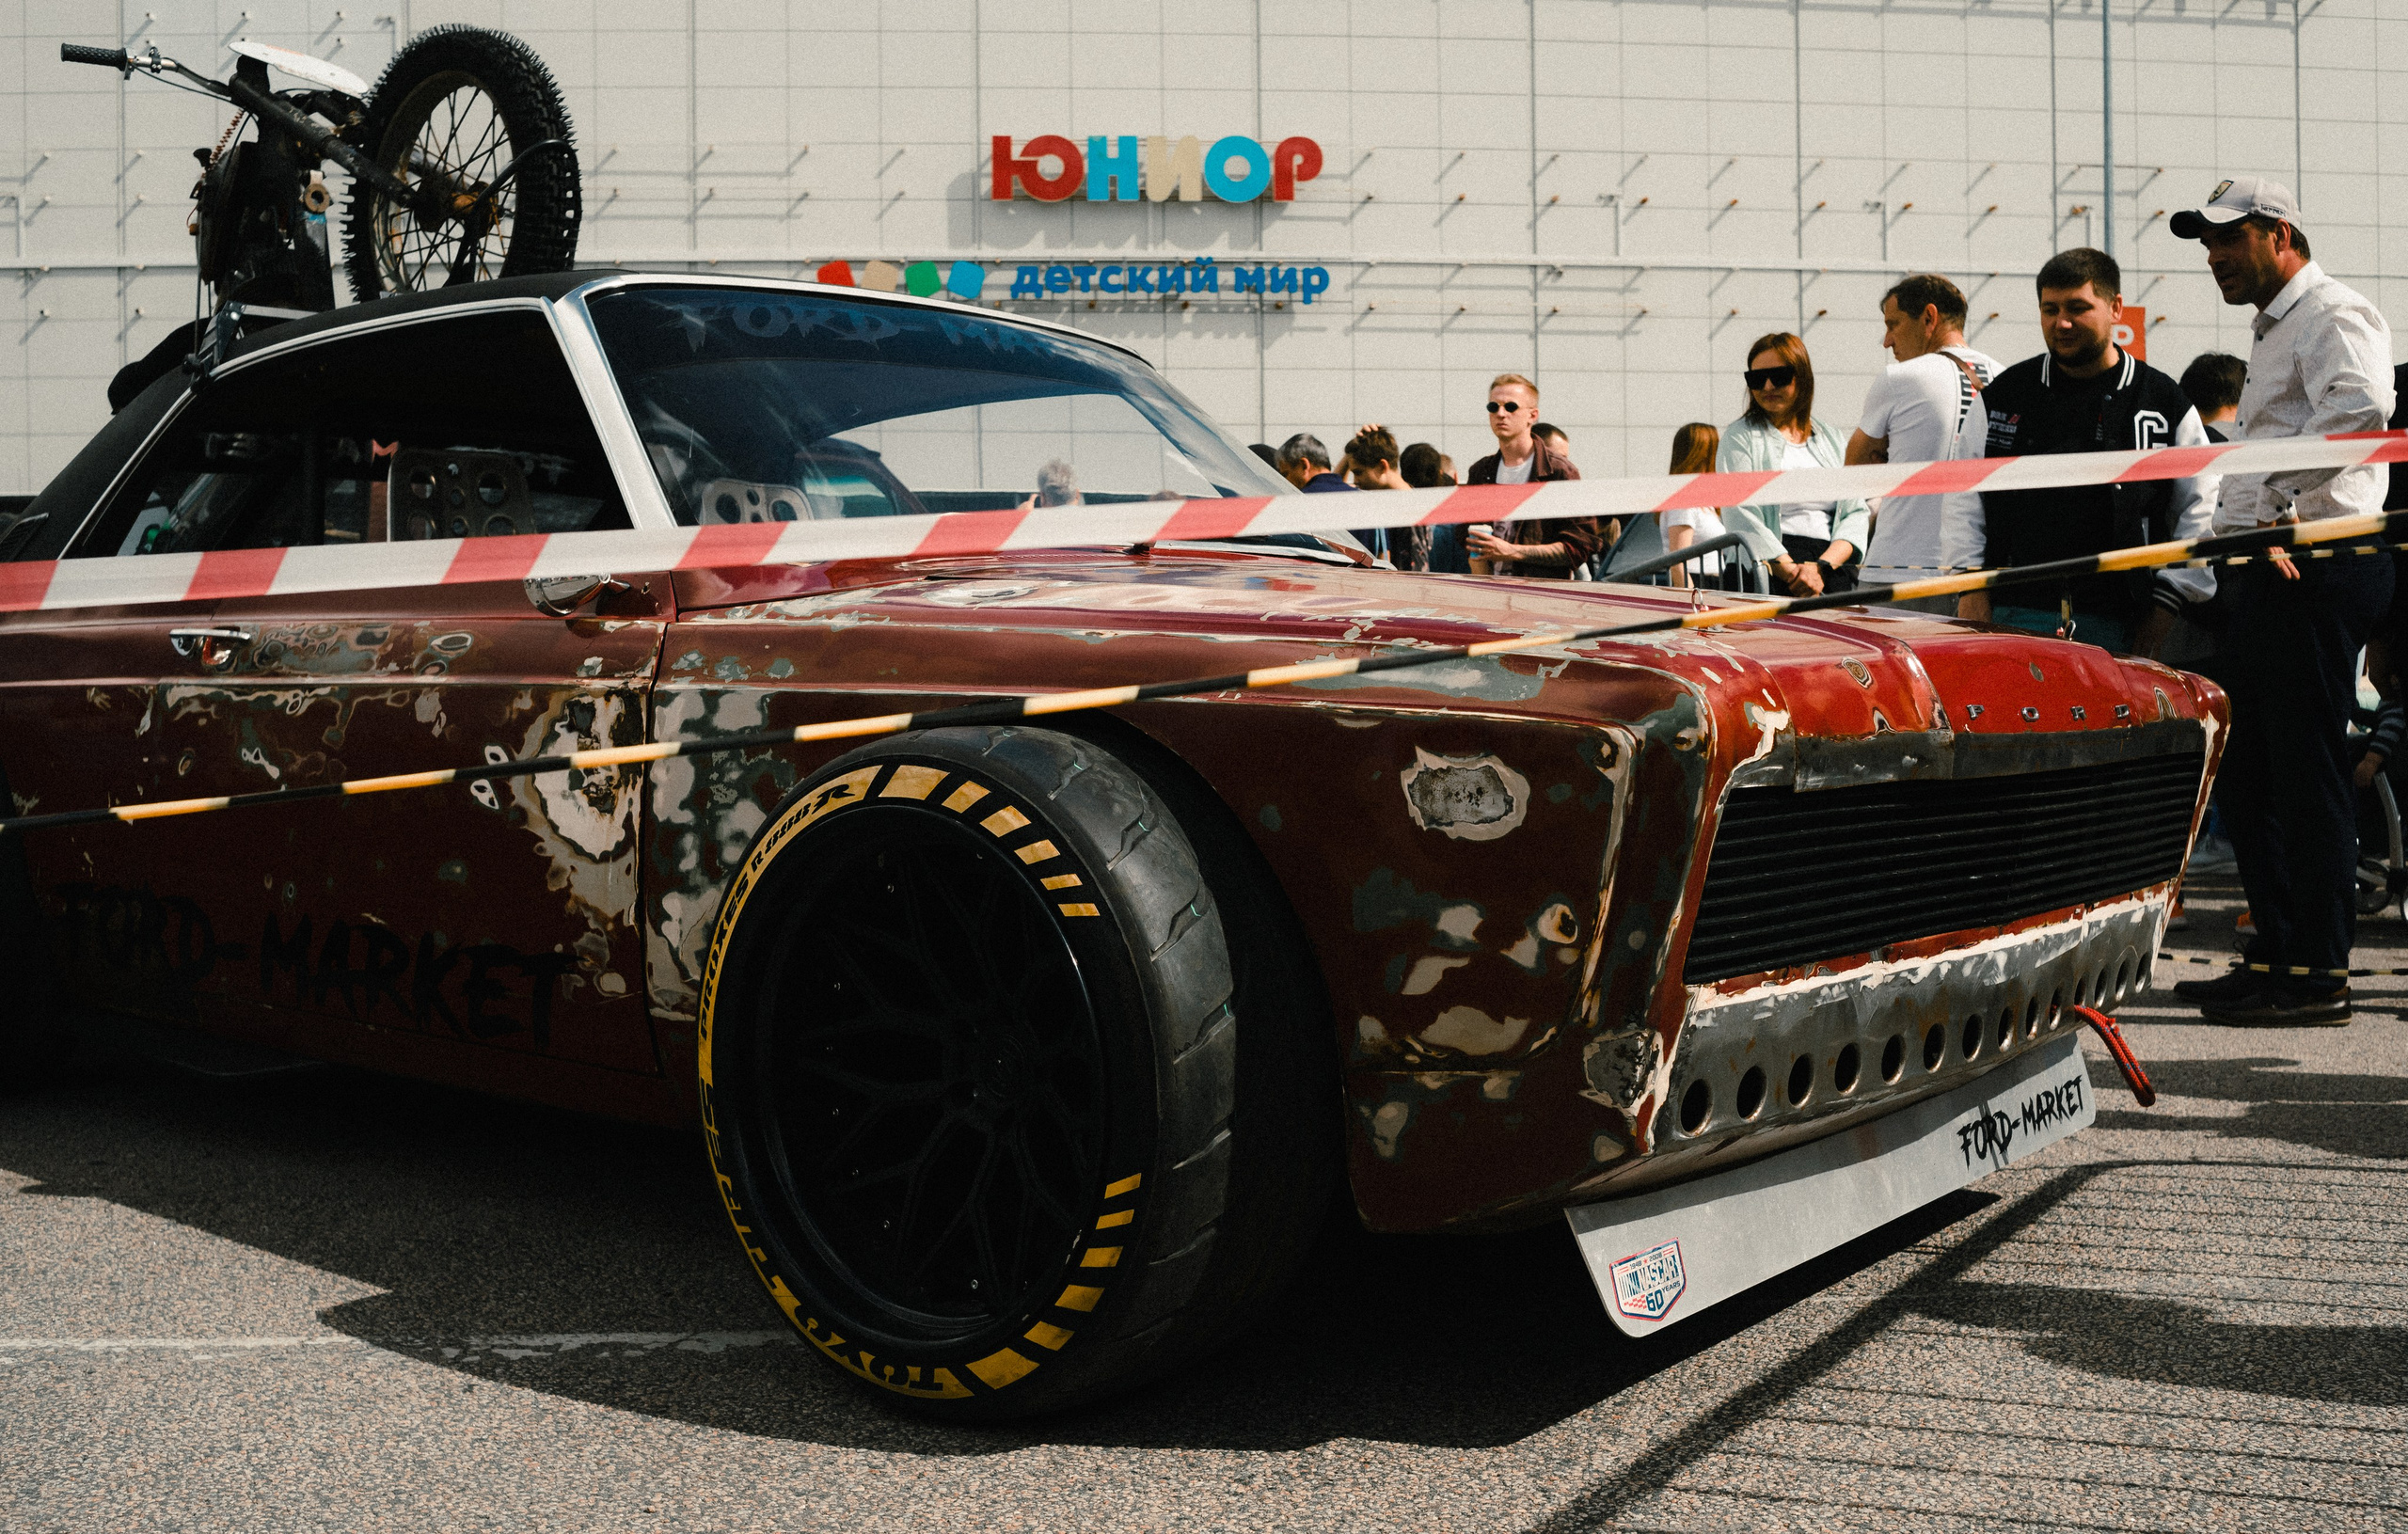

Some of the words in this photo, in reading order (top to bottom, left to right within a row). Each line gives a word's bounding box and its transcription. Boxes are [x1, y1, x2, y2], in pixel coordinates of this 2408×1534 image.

[990, 134, 1323, 203] ЮНИОР
[1010, 257, 1219, 299] детский
[1233, 266, 1329, 305] мир
[1966, 704, 2130, 722] FORD
[700, 870, 750, 1042] PROXES
[1956, 1074, 2083, 1172] FORD-MARKET
[1639, 1254, 1680, 1291] NASCAR
[1645, 1289, 1664, 1311] 60
[1662, 1280, 1681, 1293] YEARS
[792, 1303, 943, 1393] TOYO
